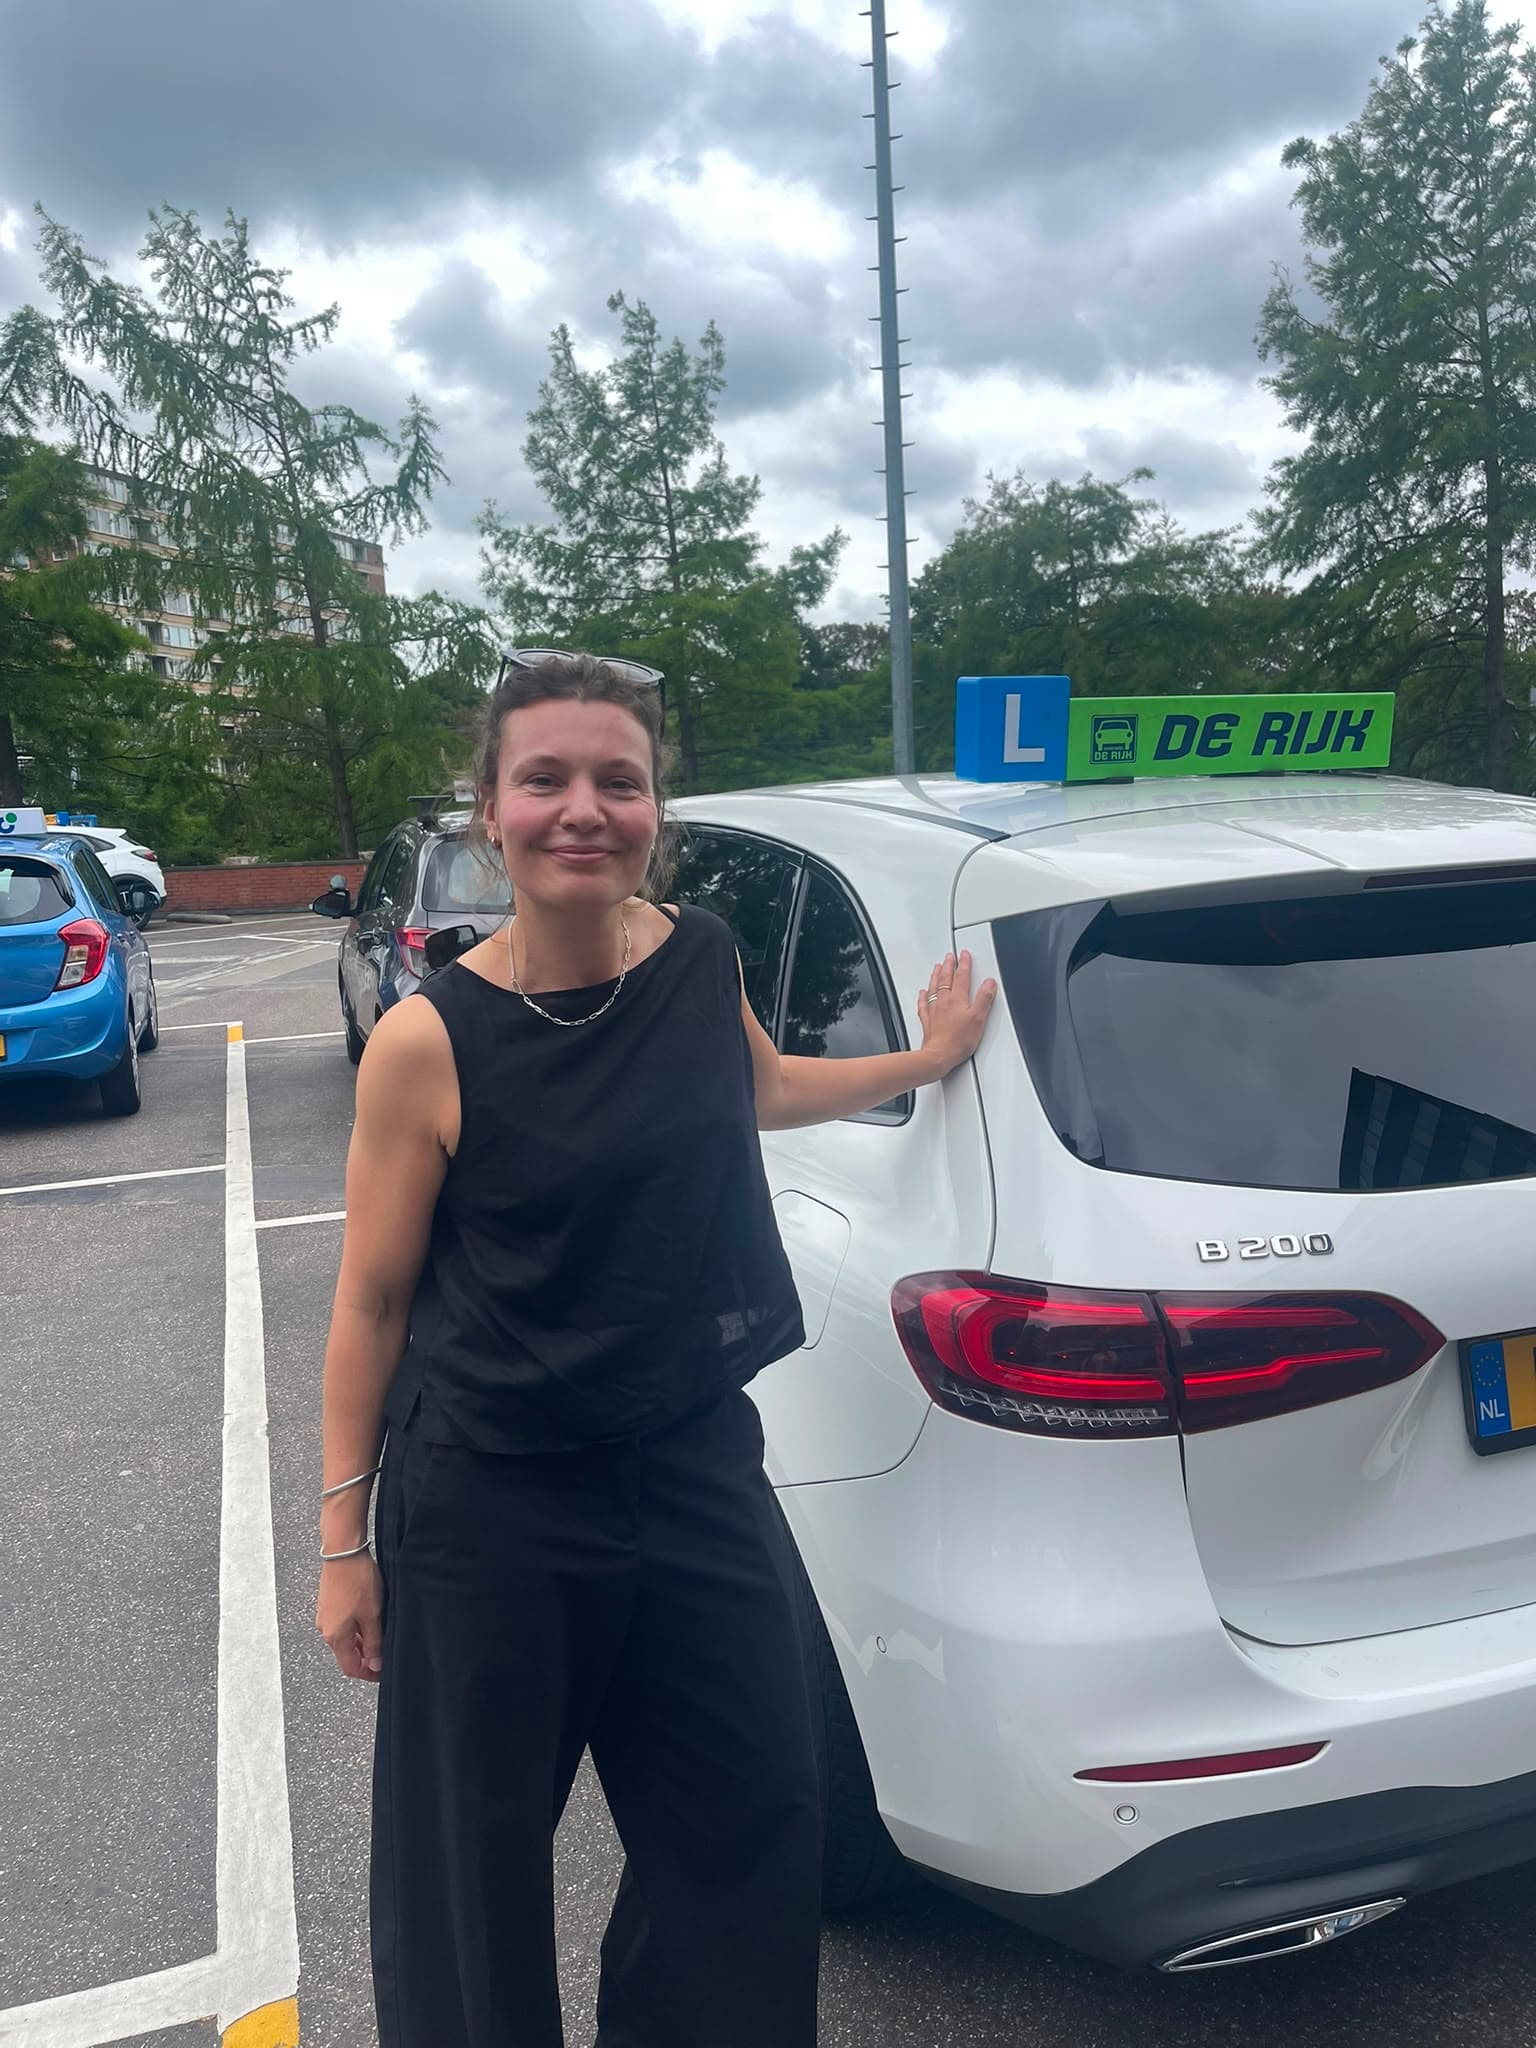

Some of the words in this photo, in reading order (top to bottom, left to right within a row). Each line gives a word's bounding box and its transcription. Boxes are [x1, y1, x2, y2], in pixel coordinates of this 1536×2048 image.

[1003, 694, 1045, 762] L
[1153, 713, 1240, 760] DE
[1251, 710, 1374, 755] RIJK
[1095, 751, 1108, 760] DE
[1111, 750, 1132, 760] RIJK
[1196, 1240, 1229, 1261] B
[1239, 1233, 1334, 1260] 200
[1480, 1399, 1505, 1420] NL
